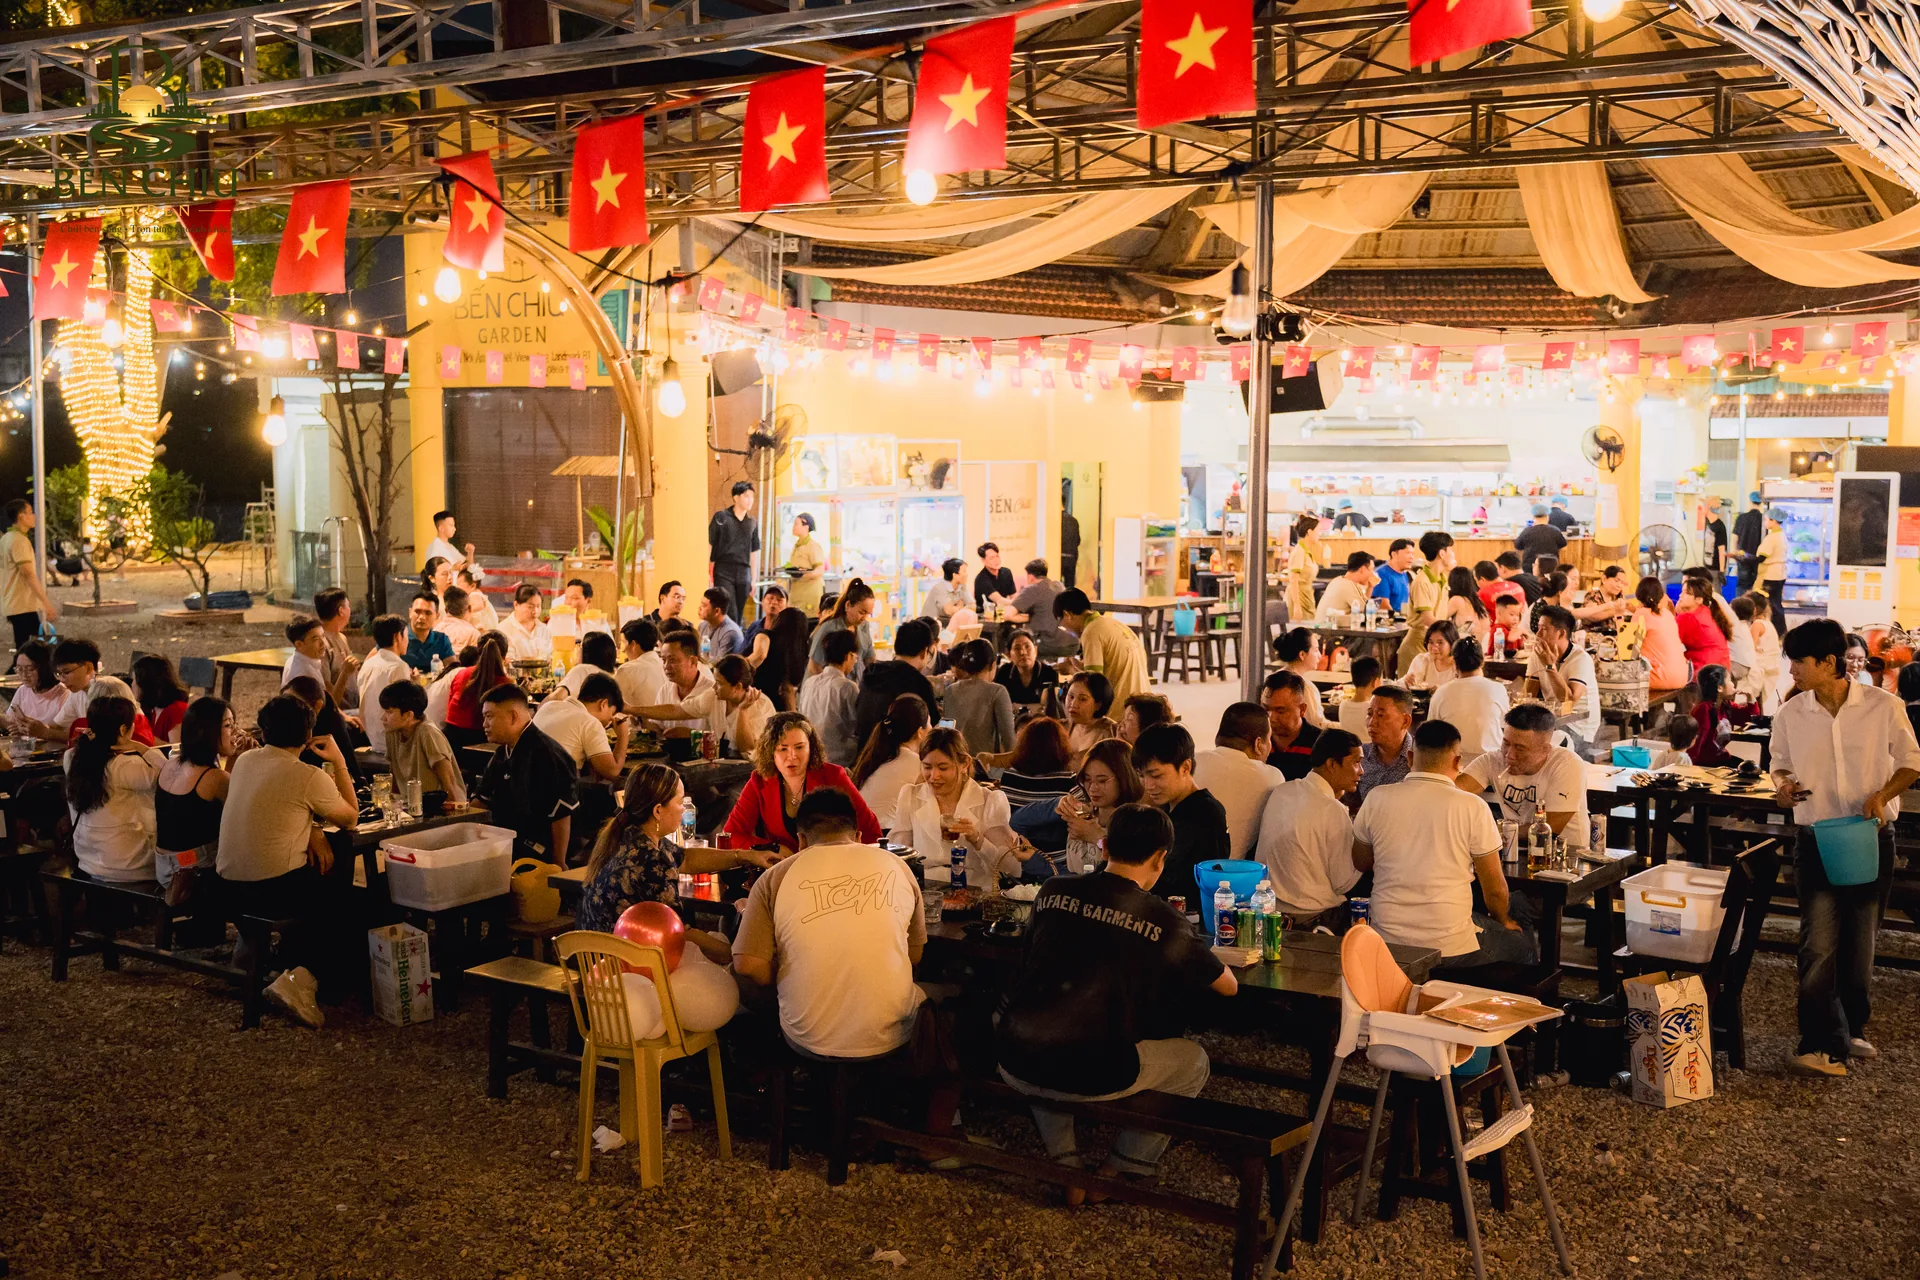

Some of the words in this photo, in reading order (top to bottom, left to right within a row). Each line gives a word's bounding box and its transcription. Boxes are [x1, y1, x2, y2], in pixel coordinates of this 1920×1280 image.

[478, 326, 547, 344] GARDEN
[1082, 903, 1163, 941] GARMENTS
[397, 959, 413, 1025] Heineken
[1643, 1044, 1660, 1086] Tiger
[1684, 1046, 1702, 1095] Tiger
